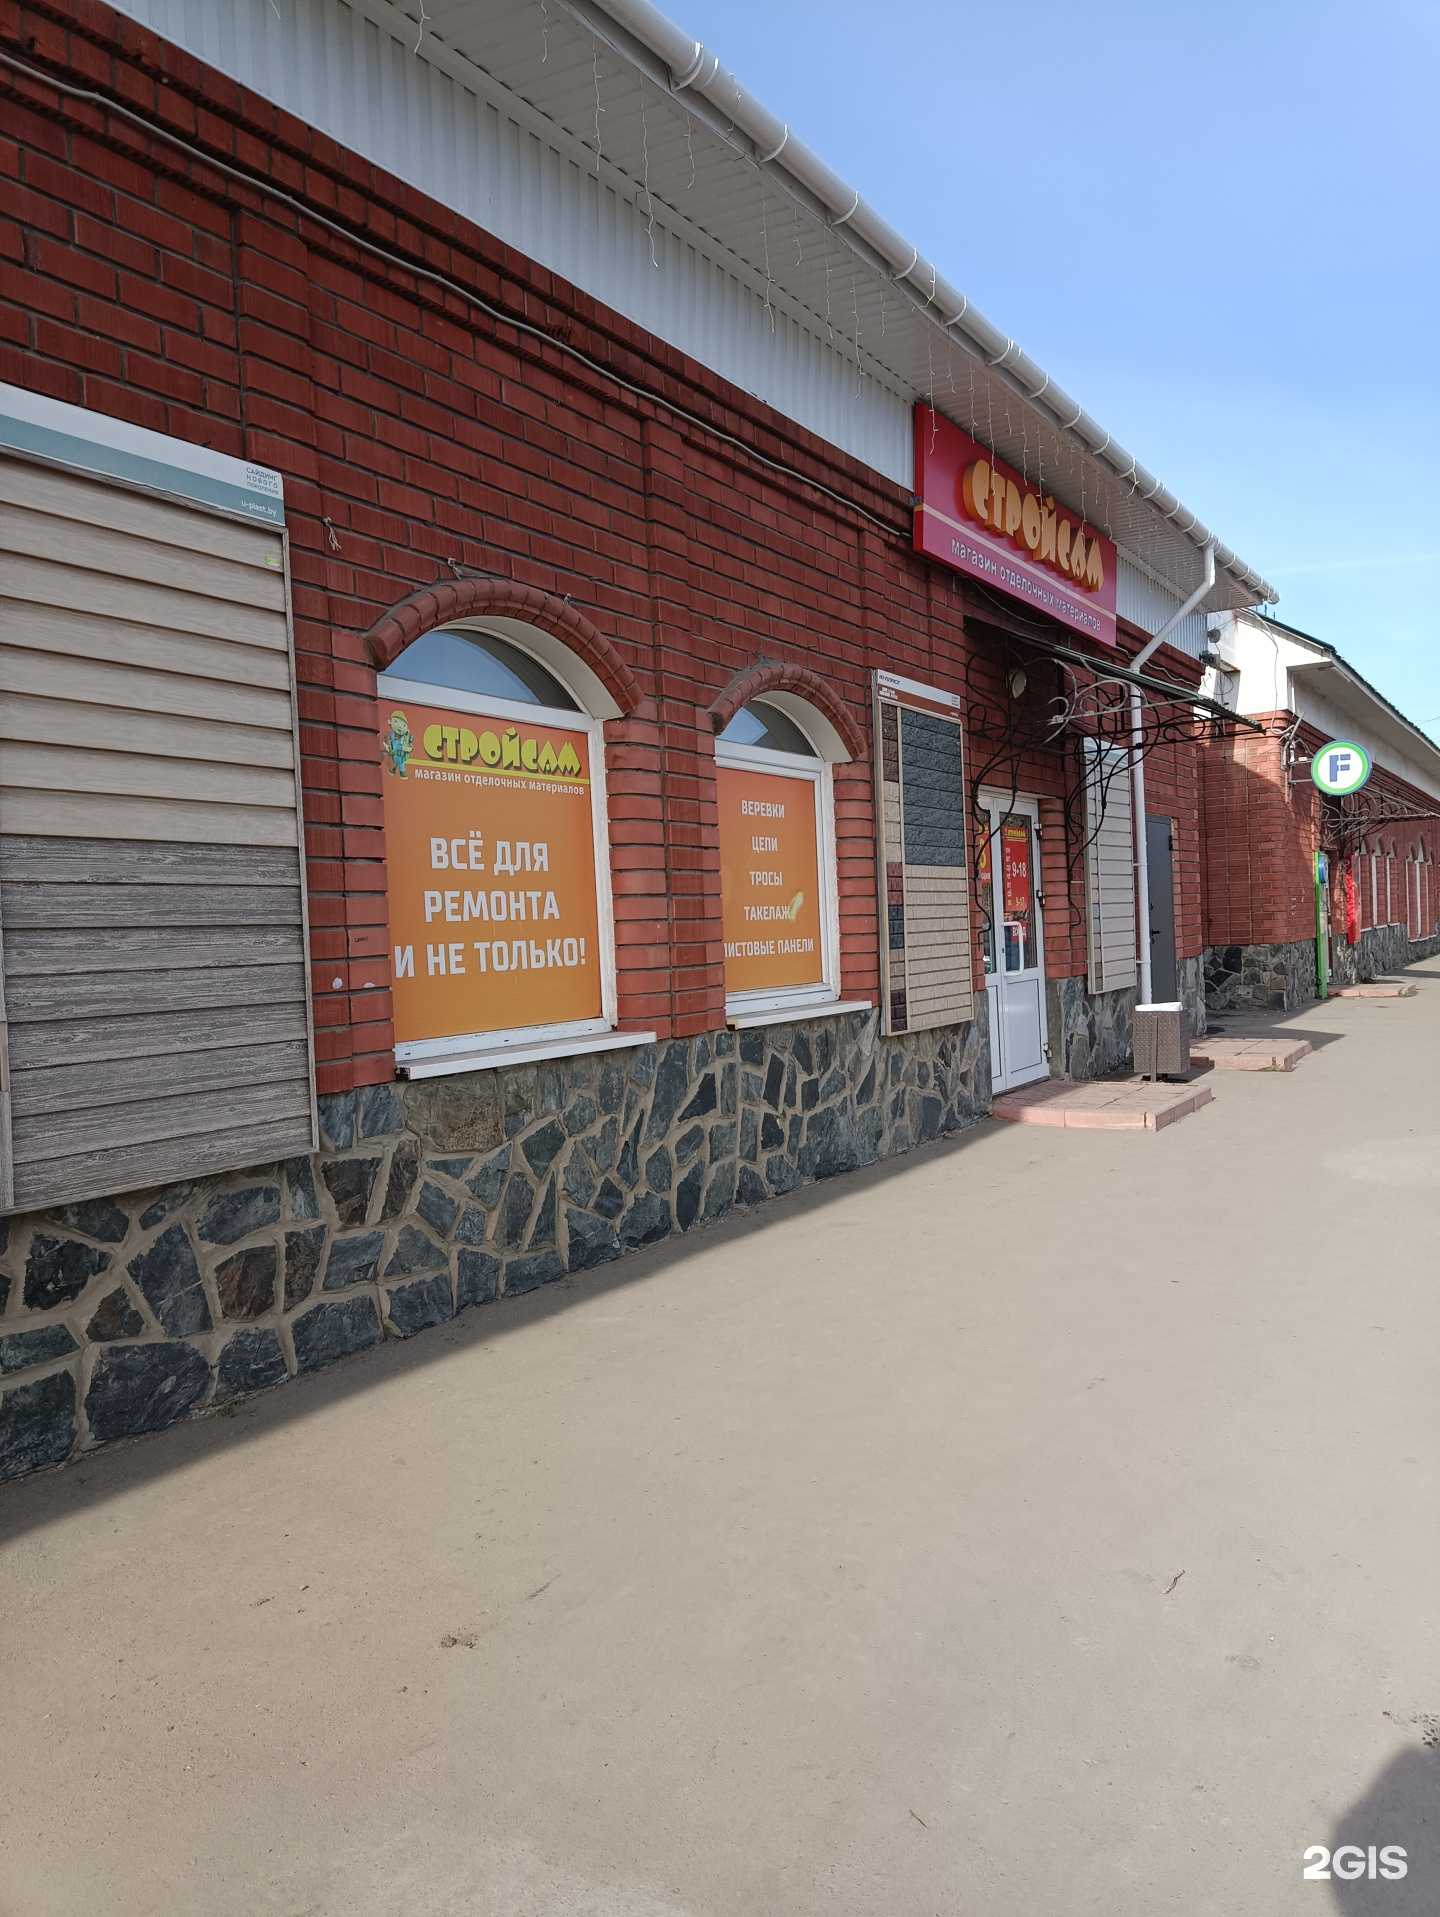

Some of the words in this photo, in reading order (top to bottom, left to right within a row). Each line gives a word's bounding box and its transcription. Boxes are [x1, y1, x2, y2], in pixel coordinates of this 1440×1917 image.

[246, 474, 279, 489] НОВОГО
[963, 459, 1104, 592] СТРОЙСАМ
[951, 539, 997, 575] магазин
[1000, 566, 1054, 607] отделочных
[1055, 598, 1101, 631] материалов
[422, 724, 582, 776] СТРОЙСАМ
[414, 768, 461, 783] магазин
[464, 774, 526, 789] отделочных
[528, 781, 585, 795] материалов
[1329, 753, 1351, 782] F
[741, 799, 785, 819] ВЕРЕВКИ
[429, 830, 485, 871] ВСЁ
[493, 839, 549, 876] ДЛЯ
[751, 836, 778, 853] ЦЕПИ
[749, 871, 784, 886] ТРОСЫ
[423, 890, 561, 923] РЕМОНТА
[744, 905, 792, 921] ТАКЕЛАЖ
[394, 945, 415, 978] И
[427, 943, 466, 976] НЕ
[474, 937, 587, 973] ТОЛЬКО!
[778, 937, 814, 955] ПАНЕЛИ
